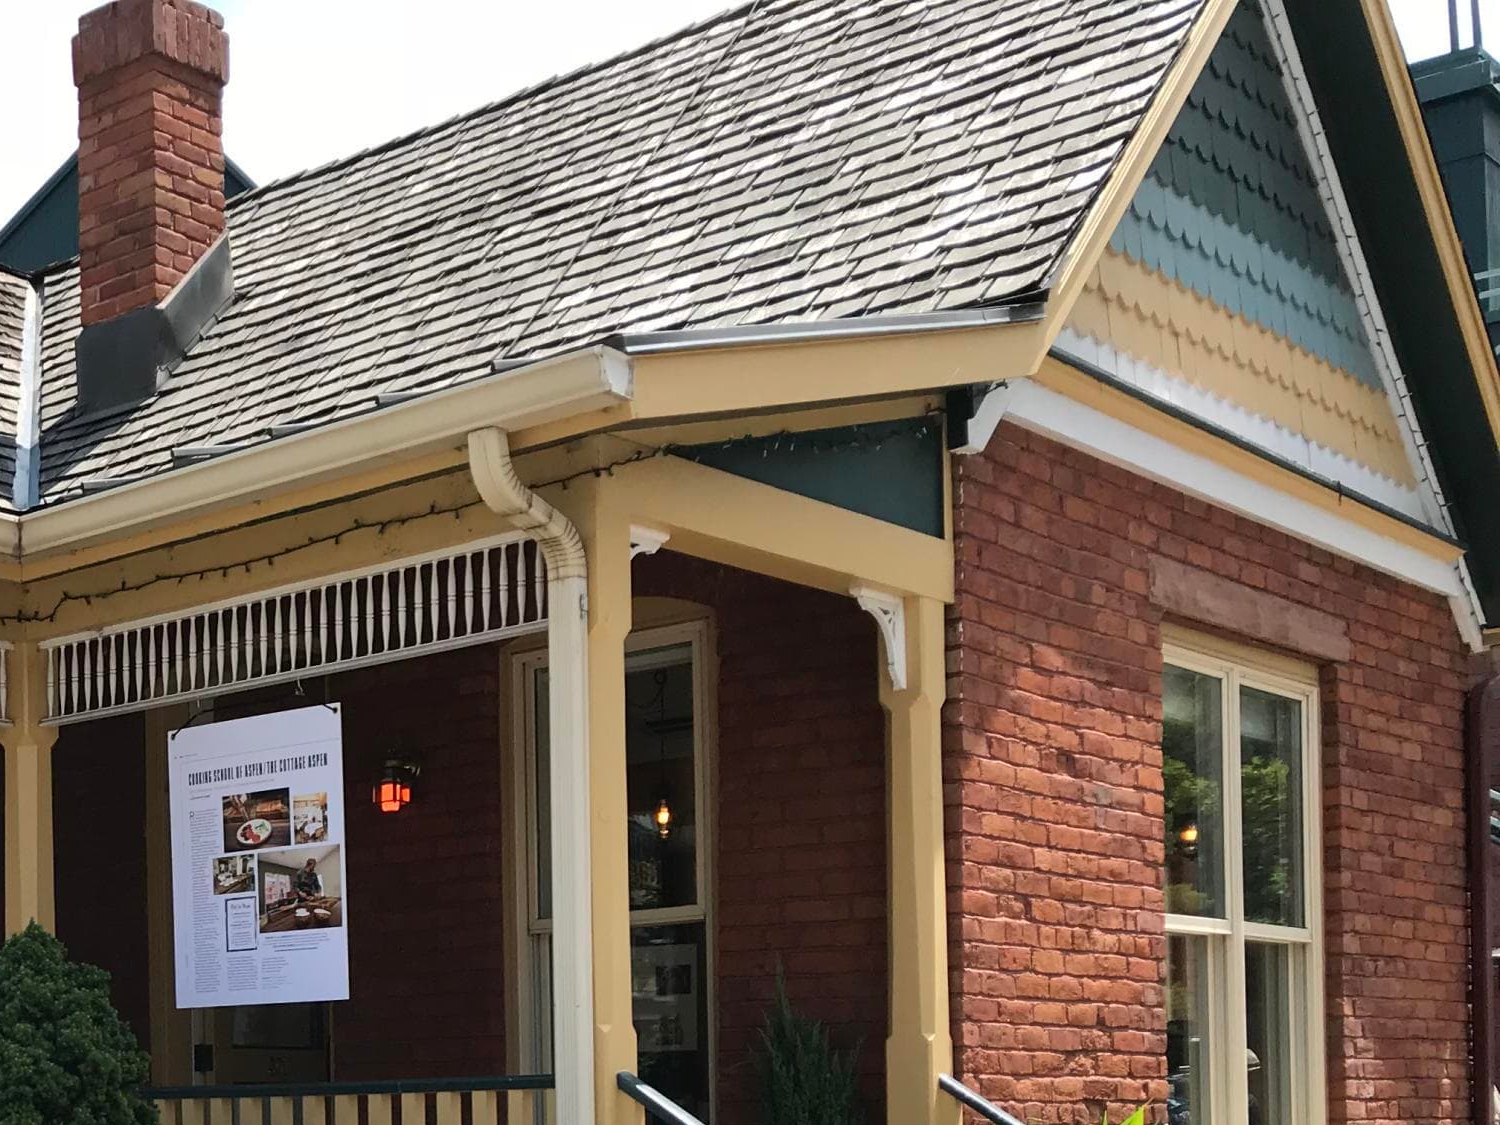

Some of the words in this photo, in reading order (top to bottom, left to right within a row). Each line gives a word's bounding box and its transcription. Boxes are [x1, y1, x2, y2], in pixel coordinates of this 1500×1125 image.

[188, 771, 212, 786] COOKING
[213, 767, 234, 783] SCHOOL
[236, 765, 243, 779] OF
[279, 756, 306, 773] COTTAGE
[308, 753, 328, 768] ASPEN
